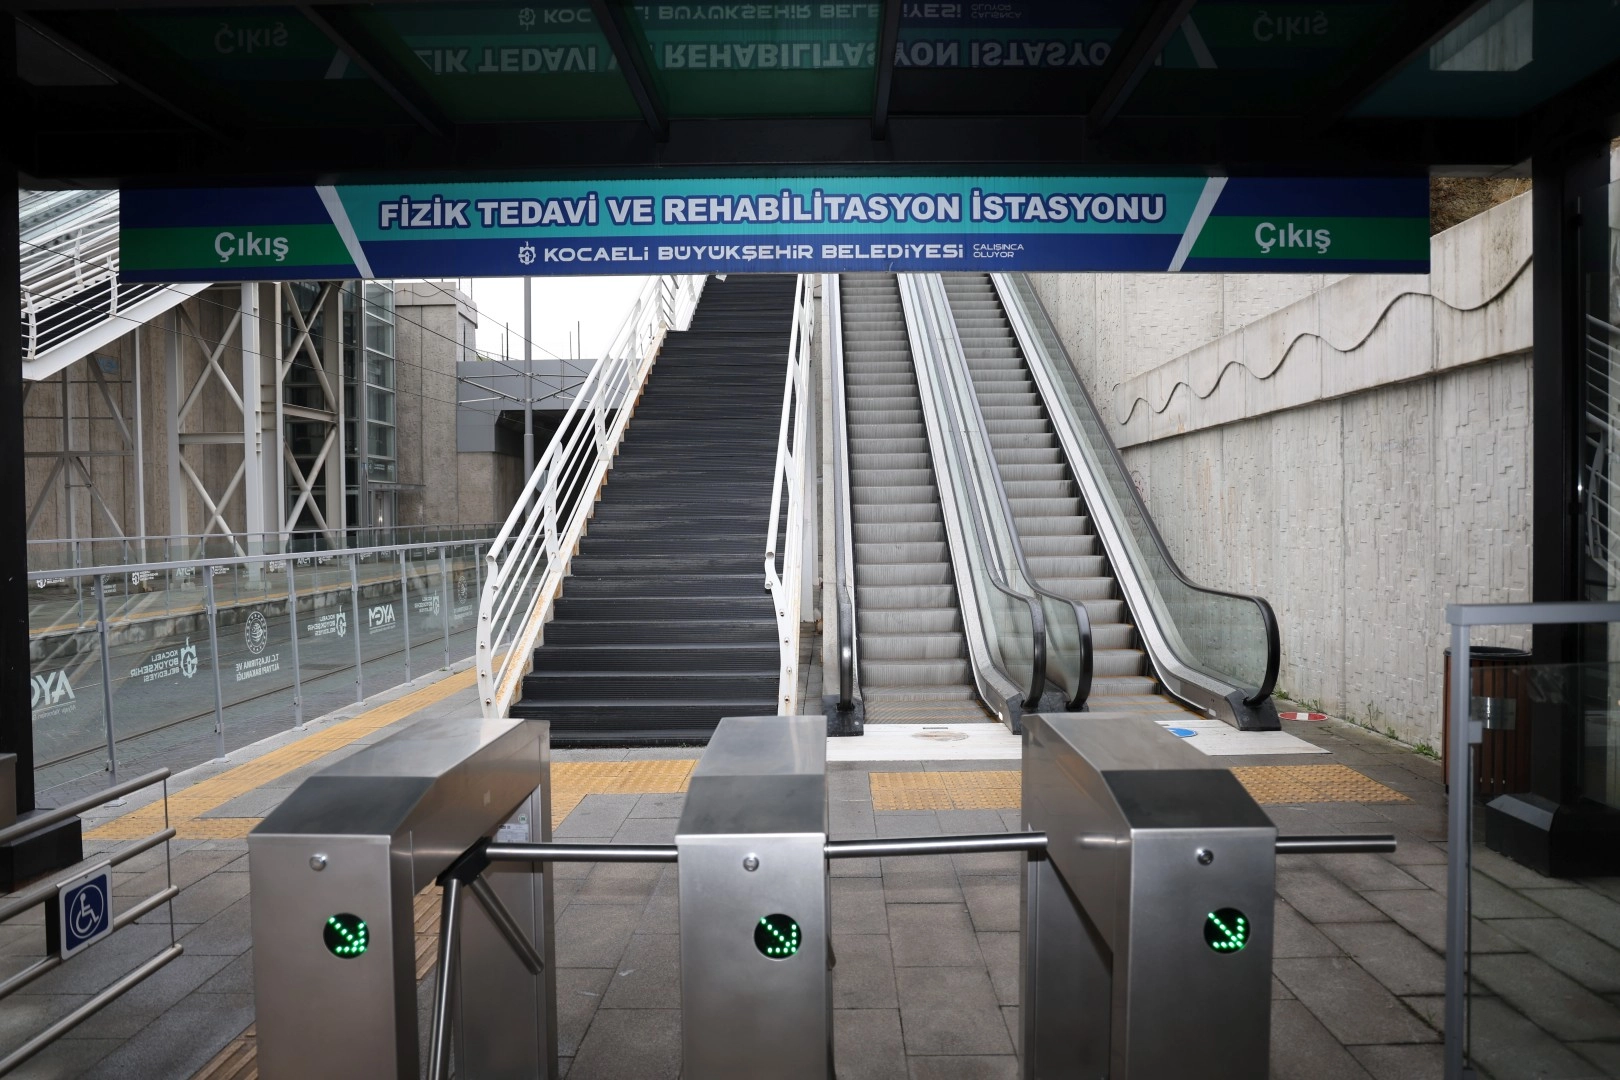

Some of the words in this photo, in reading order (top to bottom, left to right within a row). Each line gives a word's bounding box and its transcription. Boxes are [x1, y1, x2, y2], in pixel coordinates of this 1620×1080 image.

[381, 197, 468, 227] FİZİK
[477, 194, 596, 226] TEDAVİ
[607, 199, 653, 223] VE
[664, 191, 960, 222] REHABİLİTASYON
[972, 190, 1165, 221] İSTASYONU
[214, 231, 289, 263] Çıkış
[1255, 222, 1331, 254] Çıkış
